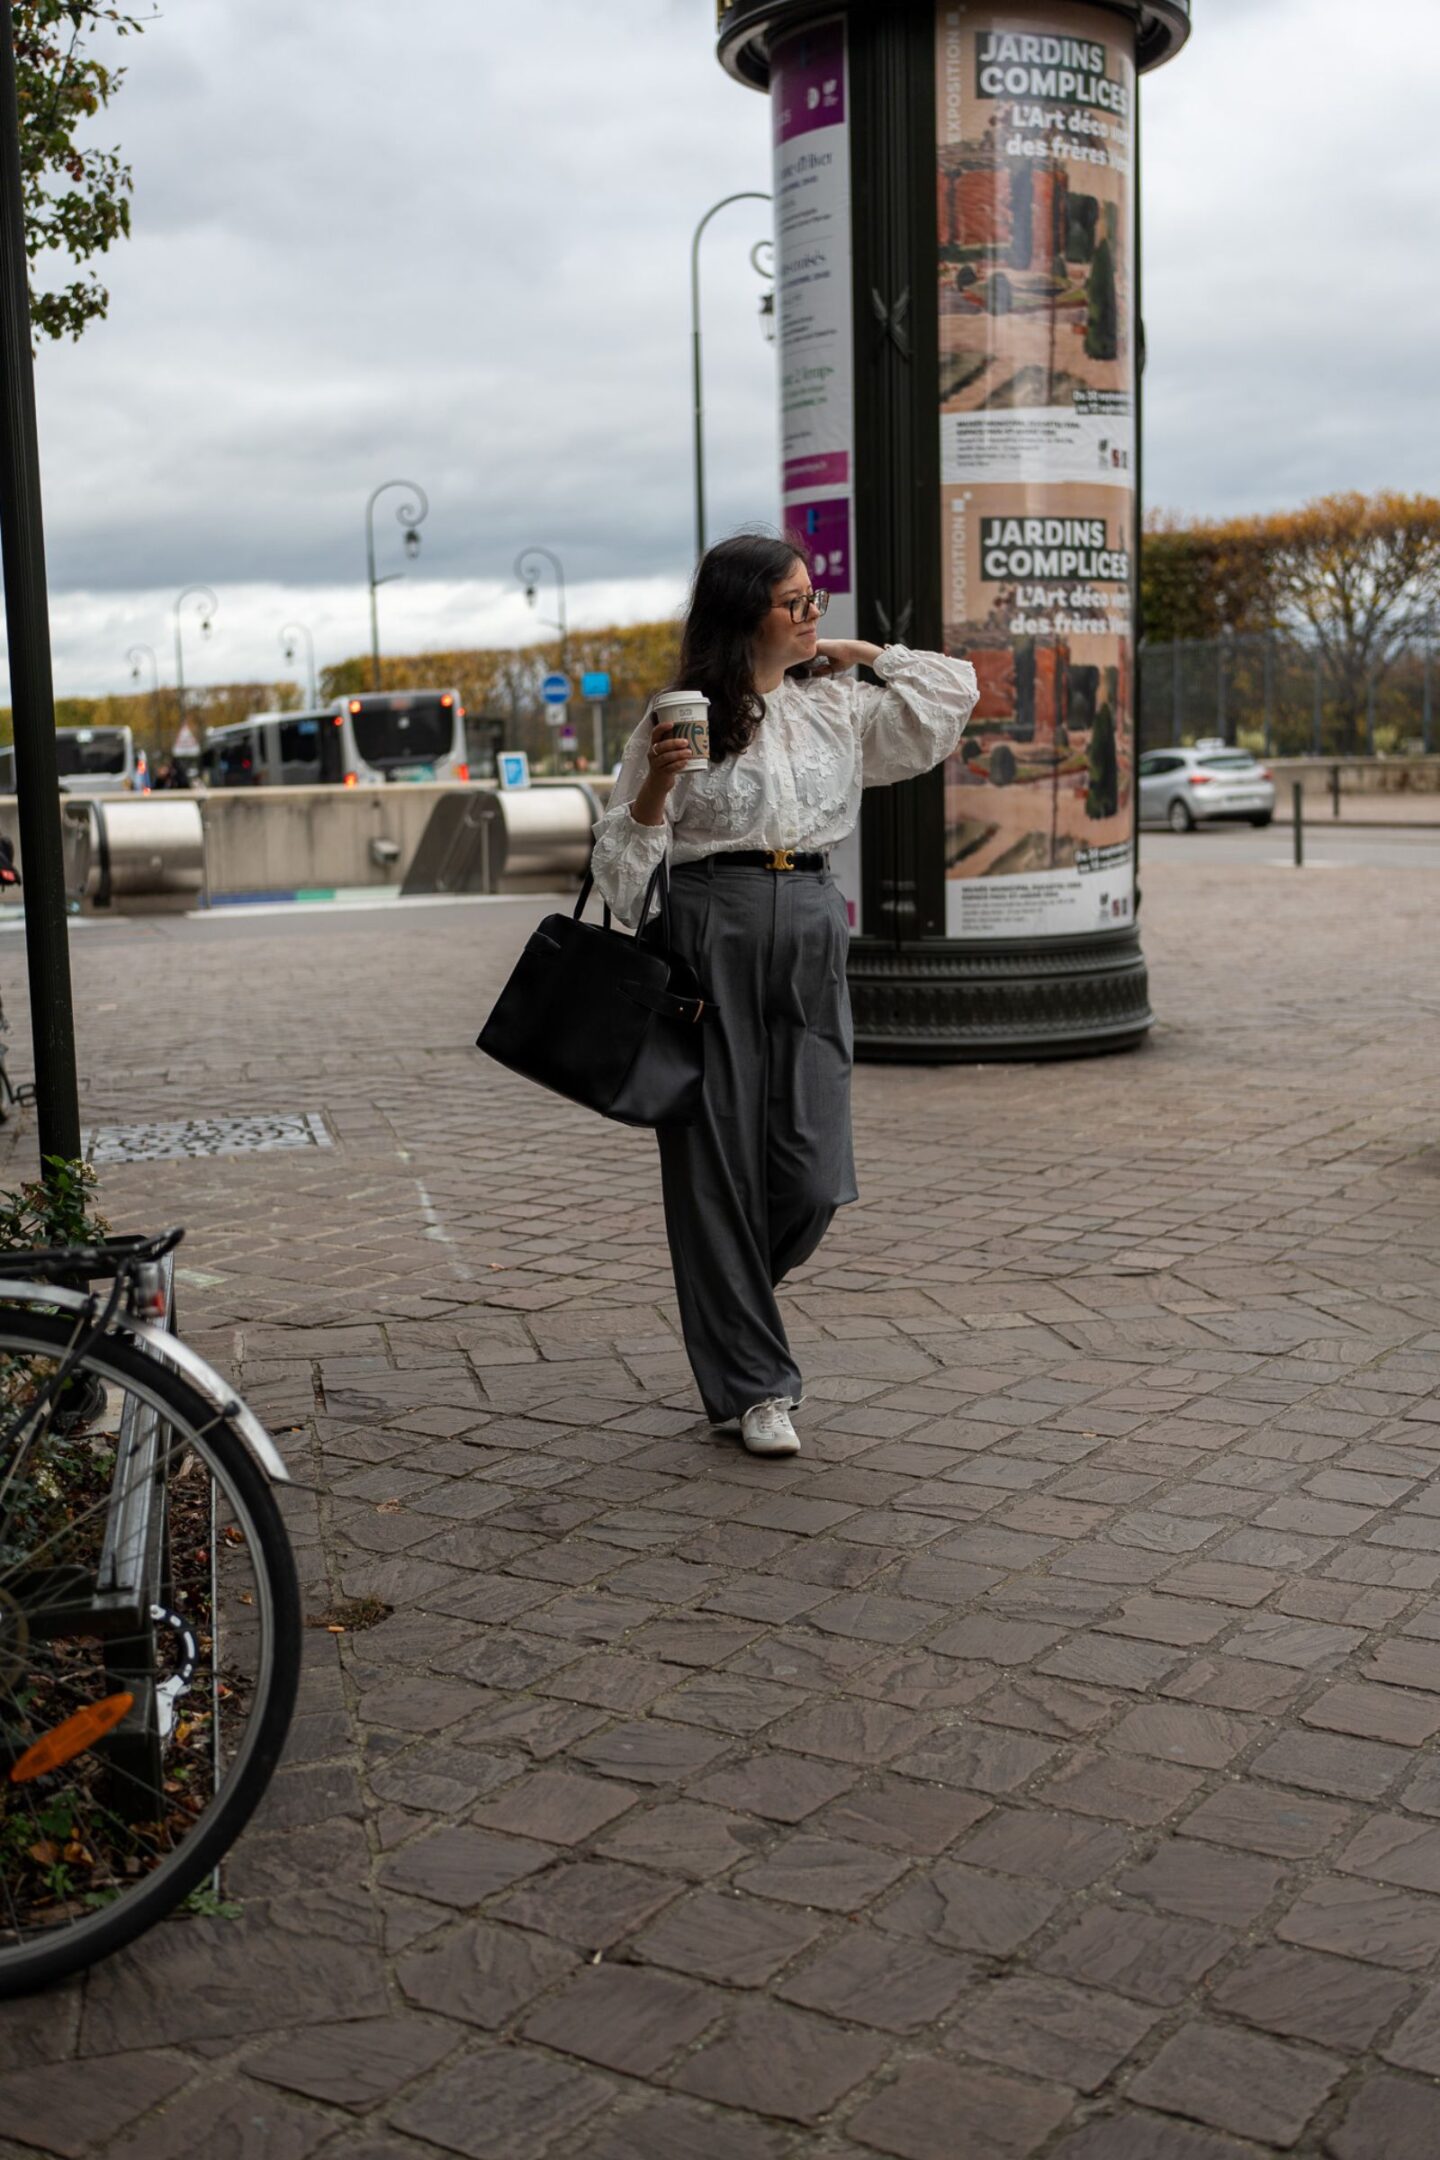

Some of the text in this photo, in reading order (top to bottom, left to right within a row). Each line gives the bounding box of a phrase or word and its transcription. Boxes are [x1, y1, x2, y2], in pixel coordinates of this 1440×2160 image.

[979, 35, 1103, 72] JARDINS
[980, 67, 1128, 113] COMPLICES
[1012, 106, 1066, 130] L'Art
[1005, 133, 1048, 157] des
[1051, 136, 1108, 165] frères
[984, 519, 1104, 548] JARDINS
[984, 550, 1128, 579] COMPLICES
[1016, 586, 1067, 607] L'Art
[1010, 613, 1049, 634] des
[1053, 612, 1106, 634] frères
